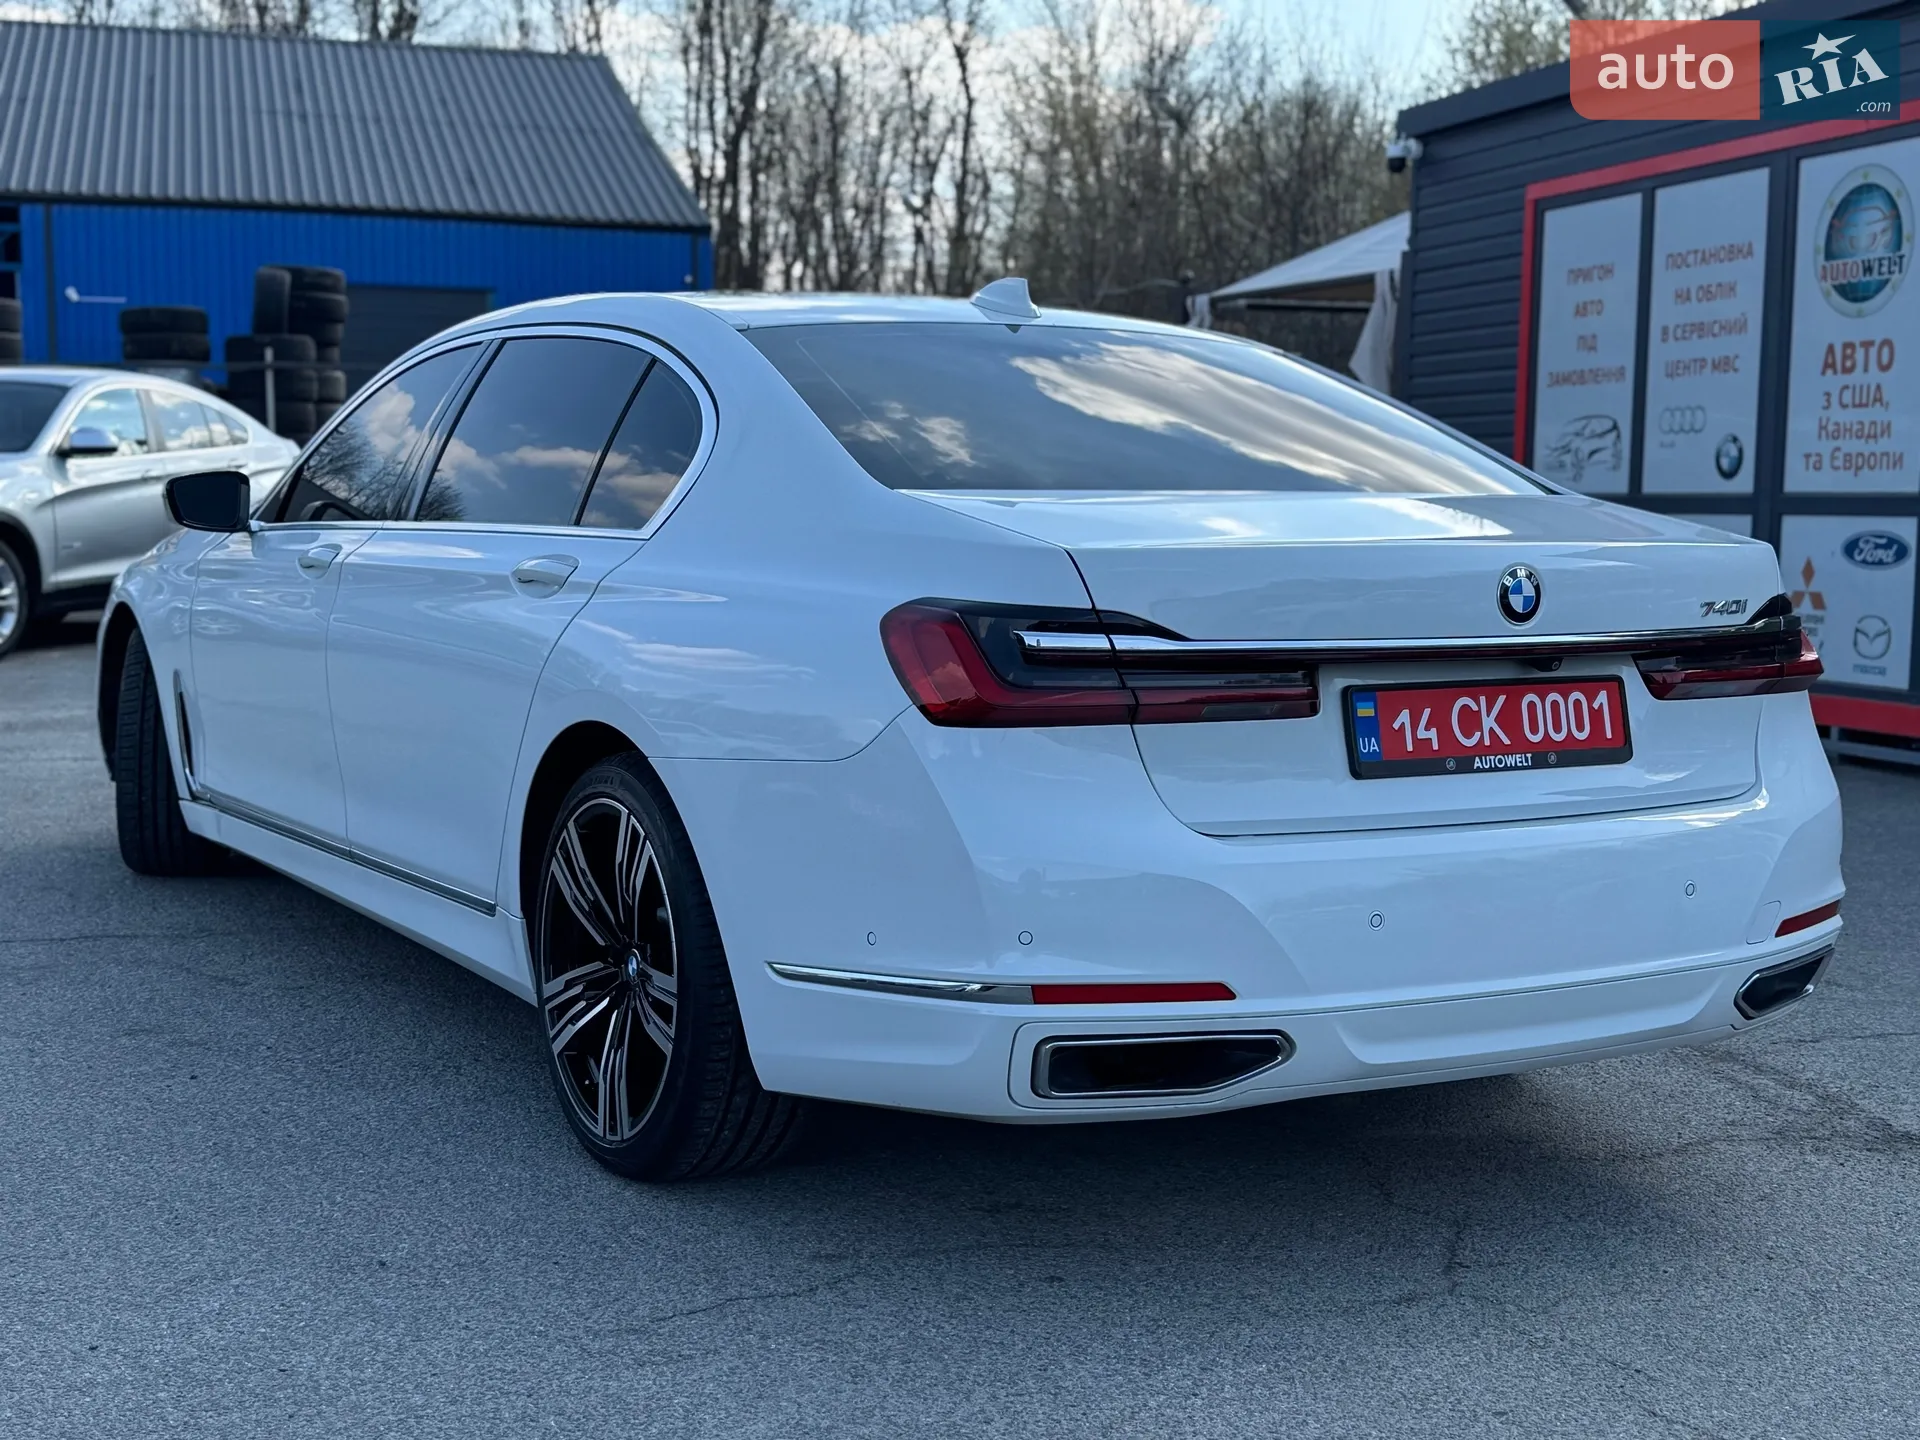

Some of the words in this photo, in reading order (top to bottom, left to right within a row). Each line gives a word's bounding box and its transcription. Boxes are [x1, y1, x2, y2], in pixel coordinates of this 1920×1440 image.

[1665, 241, 1754, 271] ПОСТАНОВКА
[1821, 253, 1906, 283] AUTOWELT
[1566, 262, 1615, 286] ПРИГОН
[1674, 286, 1692, 304] НА
[1696, 281, 1738, 303] ОБЛІК
[1574, 298, 1604, 318] АВТО
[1661, 325, 1670, 344] В
[1673, 312, 1749, 341] СЕРВІСНИЙ
[1664, 357, 1708, 380] ЦЕНТР
[1711, 354, 1740, 374] МВС
[1821, 337, 1896, 377] АВТО
[1547, 365, 1627, 388] ЗАМОВЛЕННЯ
[1838, 382, 1890, 412] США,
[1818, 416, 1892, 445] Канади
[1803, 452, 1824, 472] та
[1830, 446, 1904, 478] Європи
[1853, 535, 1899, 563] Ford
[1503, 568, 1539, 587] BMW
[1392, 708, 1439, 752] 14
[1451, 695, 1511, 748] CK
[1521, 690, 1612, 743] 0001
[1360, 737, 1380, 753] UA
[1473, 753, 1532, 770] AUTOWELT
